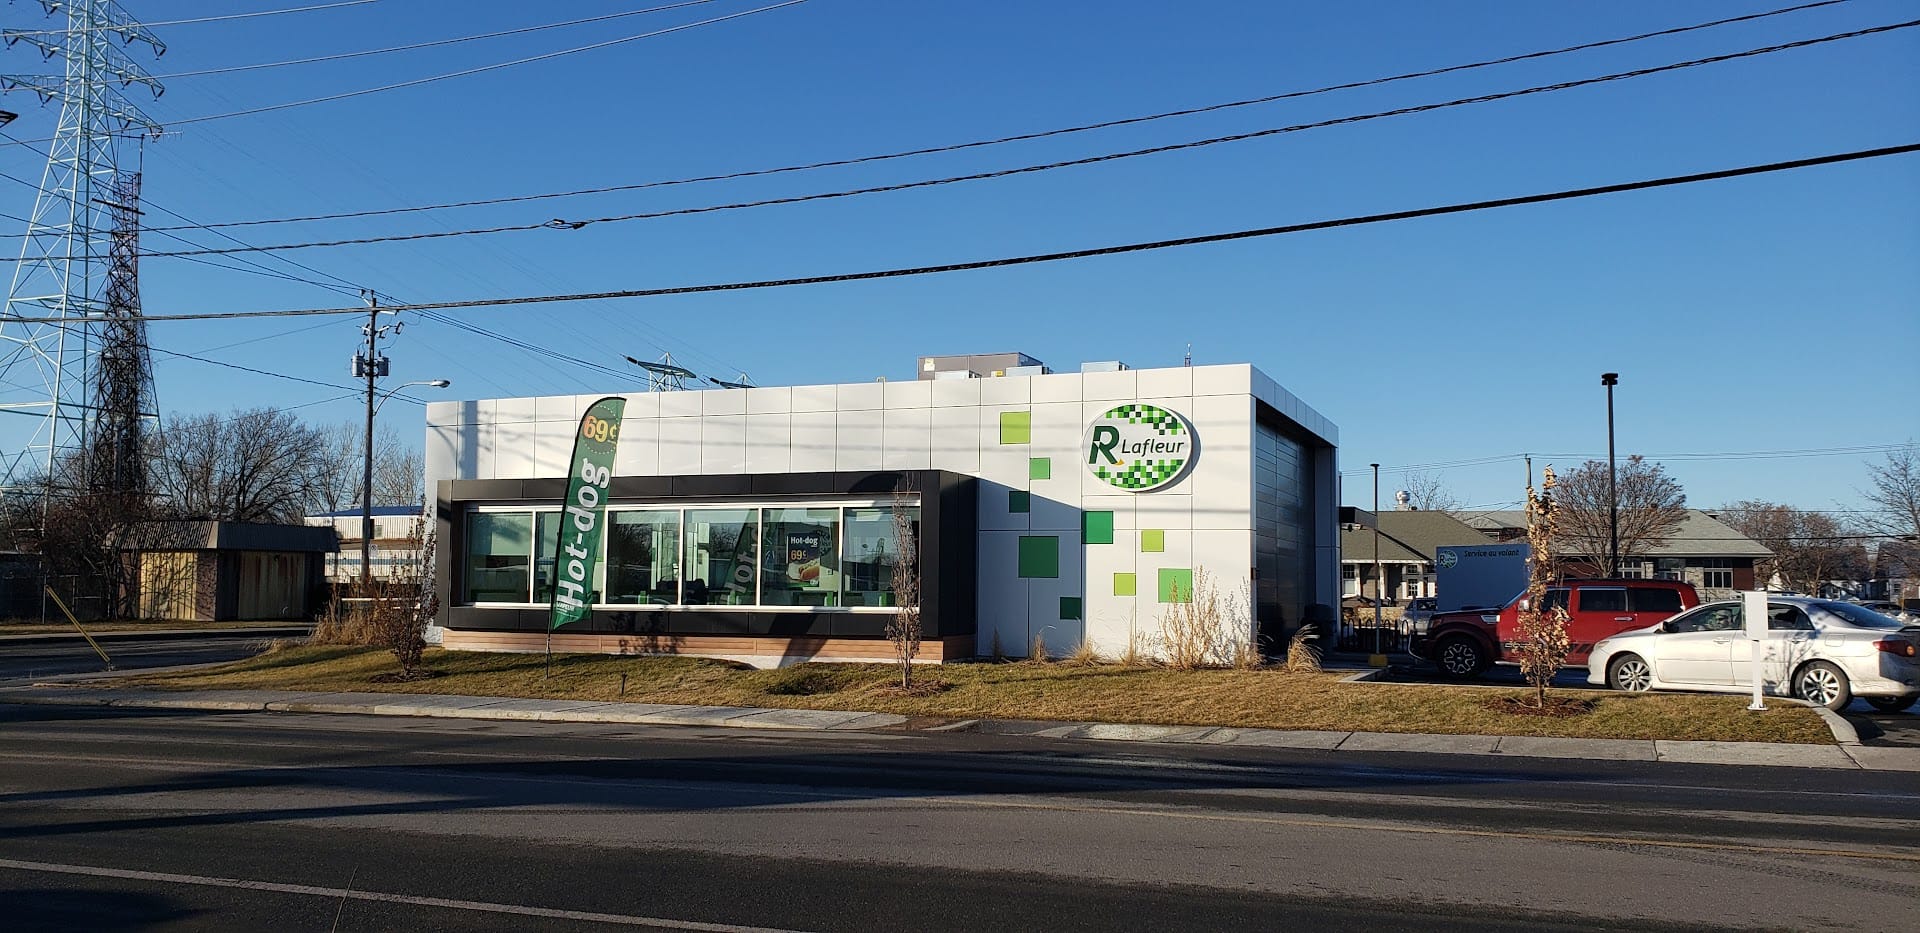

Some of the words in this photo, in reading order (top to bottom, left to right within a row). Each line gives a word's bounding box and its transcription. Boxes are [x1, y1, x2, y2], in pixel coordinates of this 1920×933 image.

[583, 415, 617, 443] 69¢
[1088, 425, 1120, 465] R
[1121, 438, 1185, 457] Lafleur
[556, 457, 611, 608] Hot-dog
[790, 536, 819, 548] Hot-dog
[1464, 550, 1487, 558] Service
[1498, 548, 1520, 557] volant
